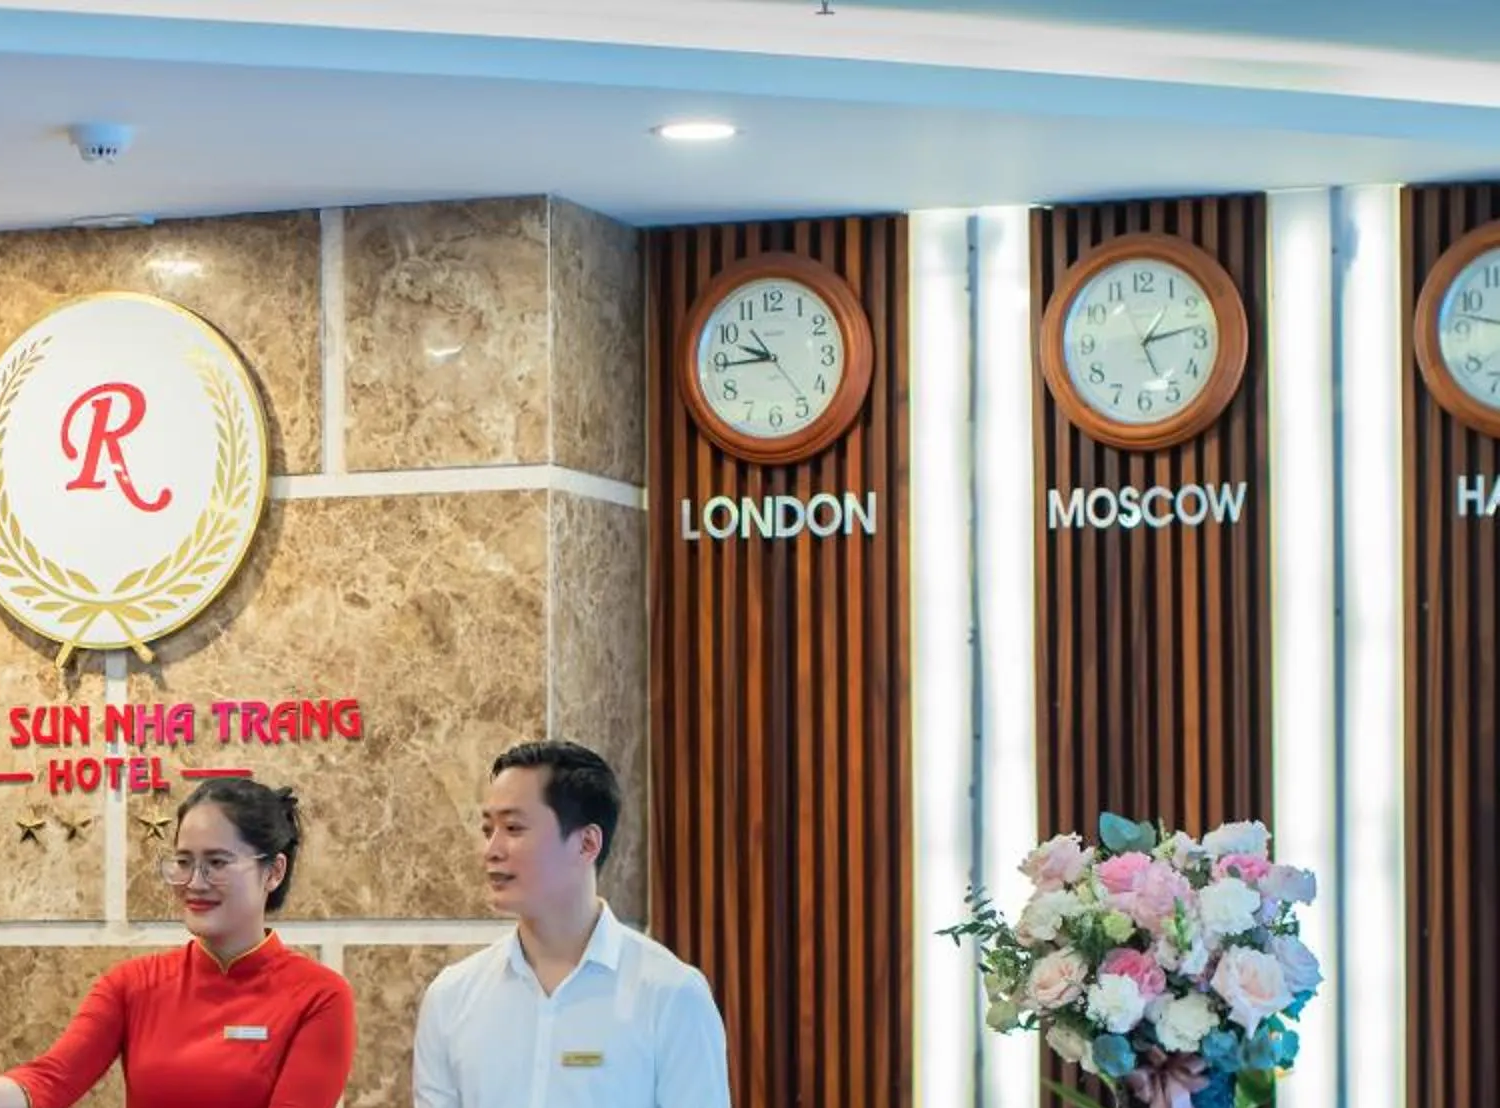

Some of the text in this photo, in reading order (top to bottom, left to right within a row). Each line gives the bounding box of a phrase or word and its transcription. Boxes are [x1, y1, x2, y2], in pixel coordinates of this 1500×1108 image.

[1133, 271, 1155, 293] 12
[1485, 267, 1499, 288] 11
[1109, 282, 1122, 302] 11
[1168, 278, 1174, 299] 1
[740, 301, 753, 320] 11
[763, 290, 784, 312] 12
[798, 297, 803, 317] 1
[1185, 296, 1199, 318] 2
[1463, 290, 1483, 312] 10
[812, 314, 827, 336] 2
[1087, 304, 1106, 325] 10
[720, 323, 739, 344] 10
[1194, 328, 1208, 350] 3
[1081, 334, 1095, 355] 9
[714, 352, 728, 373] 9
[821, 345, 835, 366] 3
[1089, 362, 1105, 384] 8
[1186, 358, 1198, 379] 4
[723, 379, 738, 401] 8
[814, 374, 826, 394] 4
[1110, 384, 1122, 405] 7
[1166, 381, 1180, 403] 5
[744, 401, 754, 421] 7
[795, 397, 809, 418] 5
[1138, 390, 1152, 411] 6
[769, 406, 783, 428] 6
[61, 381, 173, 513] R
[682, 492, 877, 540] LONDON
[1049, 482, 1248, 529] MOSCOW
[9, 704, 92, 748] SUN
[105, 702, 195, 748] NHA
[212, 698, 364, 745] TRANG
[49, 757, 171, 795] HOTEL
